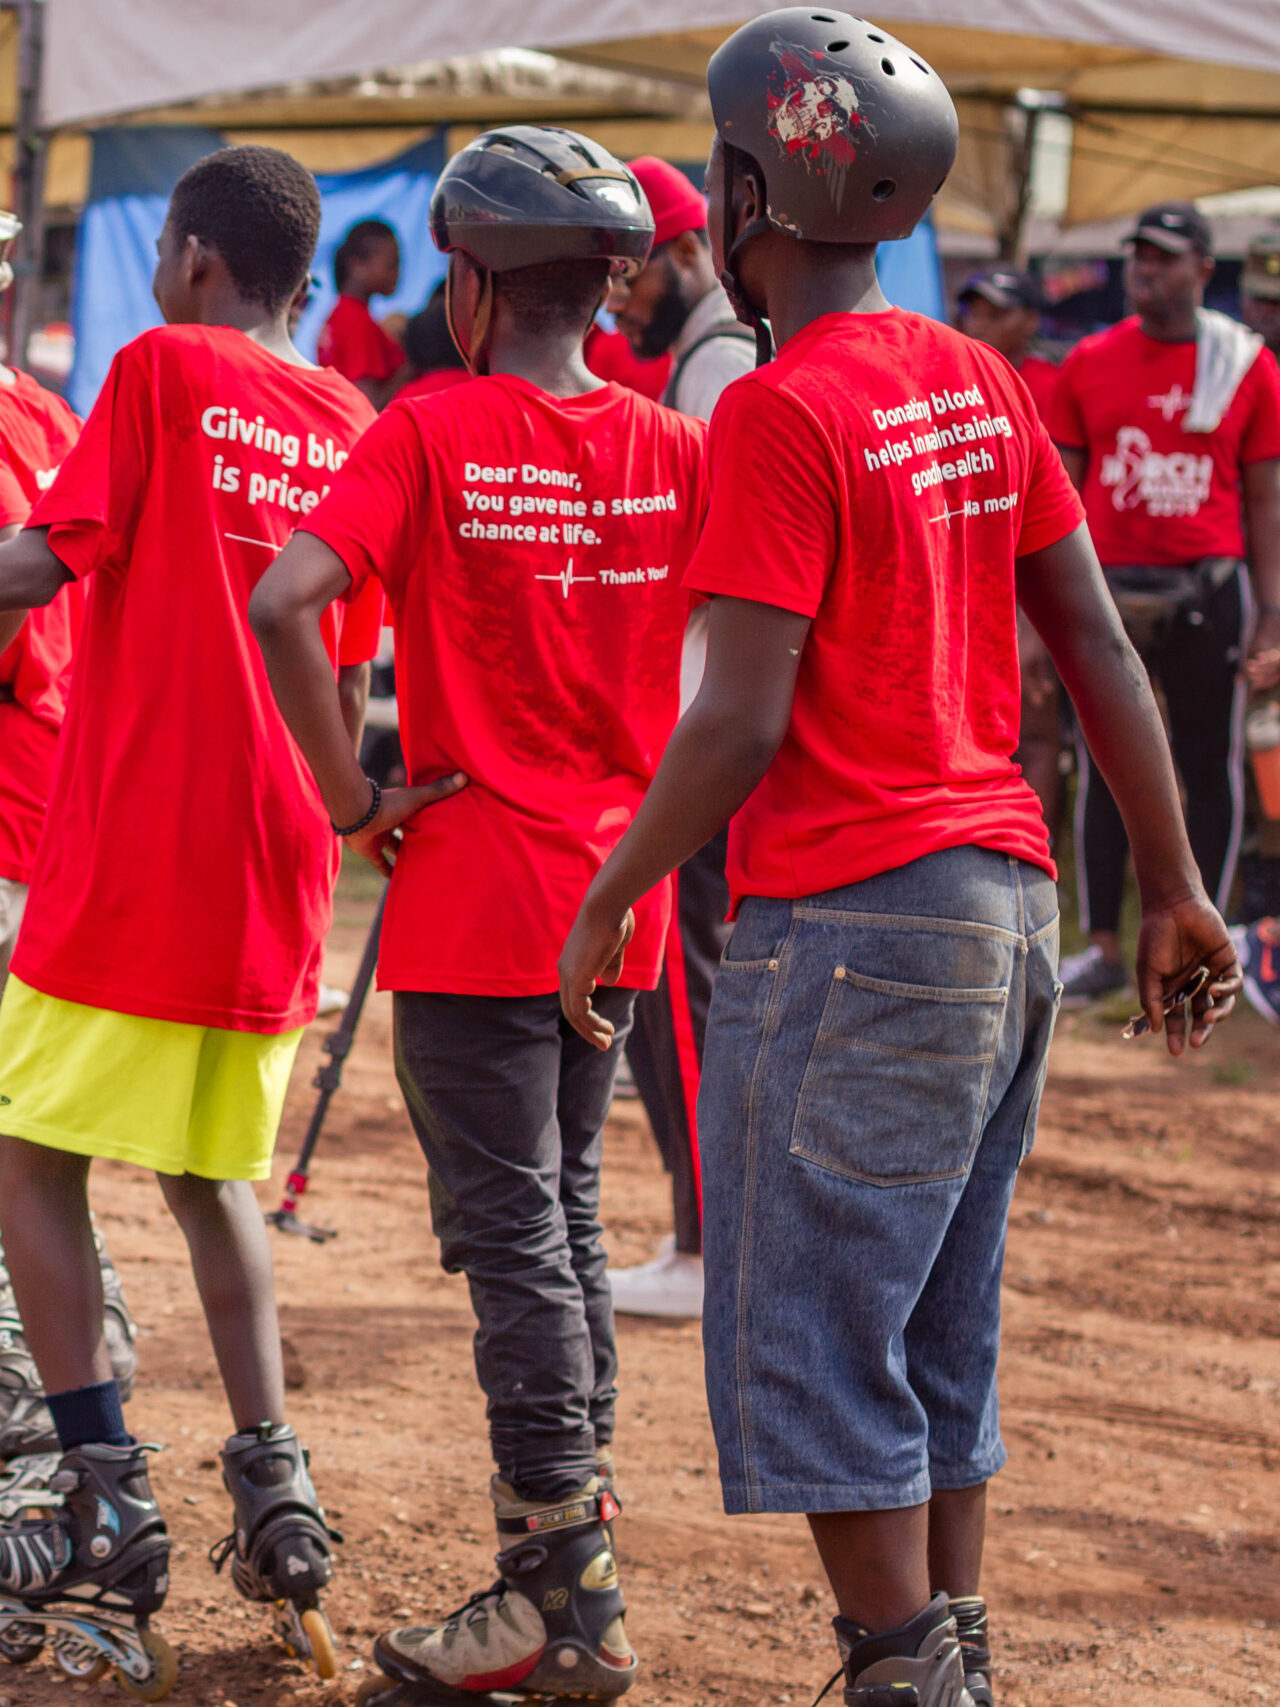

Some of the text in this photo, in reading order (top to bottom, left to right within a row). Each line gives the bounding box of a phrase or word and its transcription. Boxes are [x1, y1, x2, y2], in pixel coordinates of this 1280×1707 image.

[930, 384, 984, 415] blood
[201, 406, 300, 467] Giving
[864, 440, 913, 471] helps
[212, 454, 330, 515] is price
[464, 462, 517, 484] Dear
[462, 489, 677, 517] You gave me a second
[458, 518, 602, 545] chance at life.
[598, 567, 646, 585] Thank
